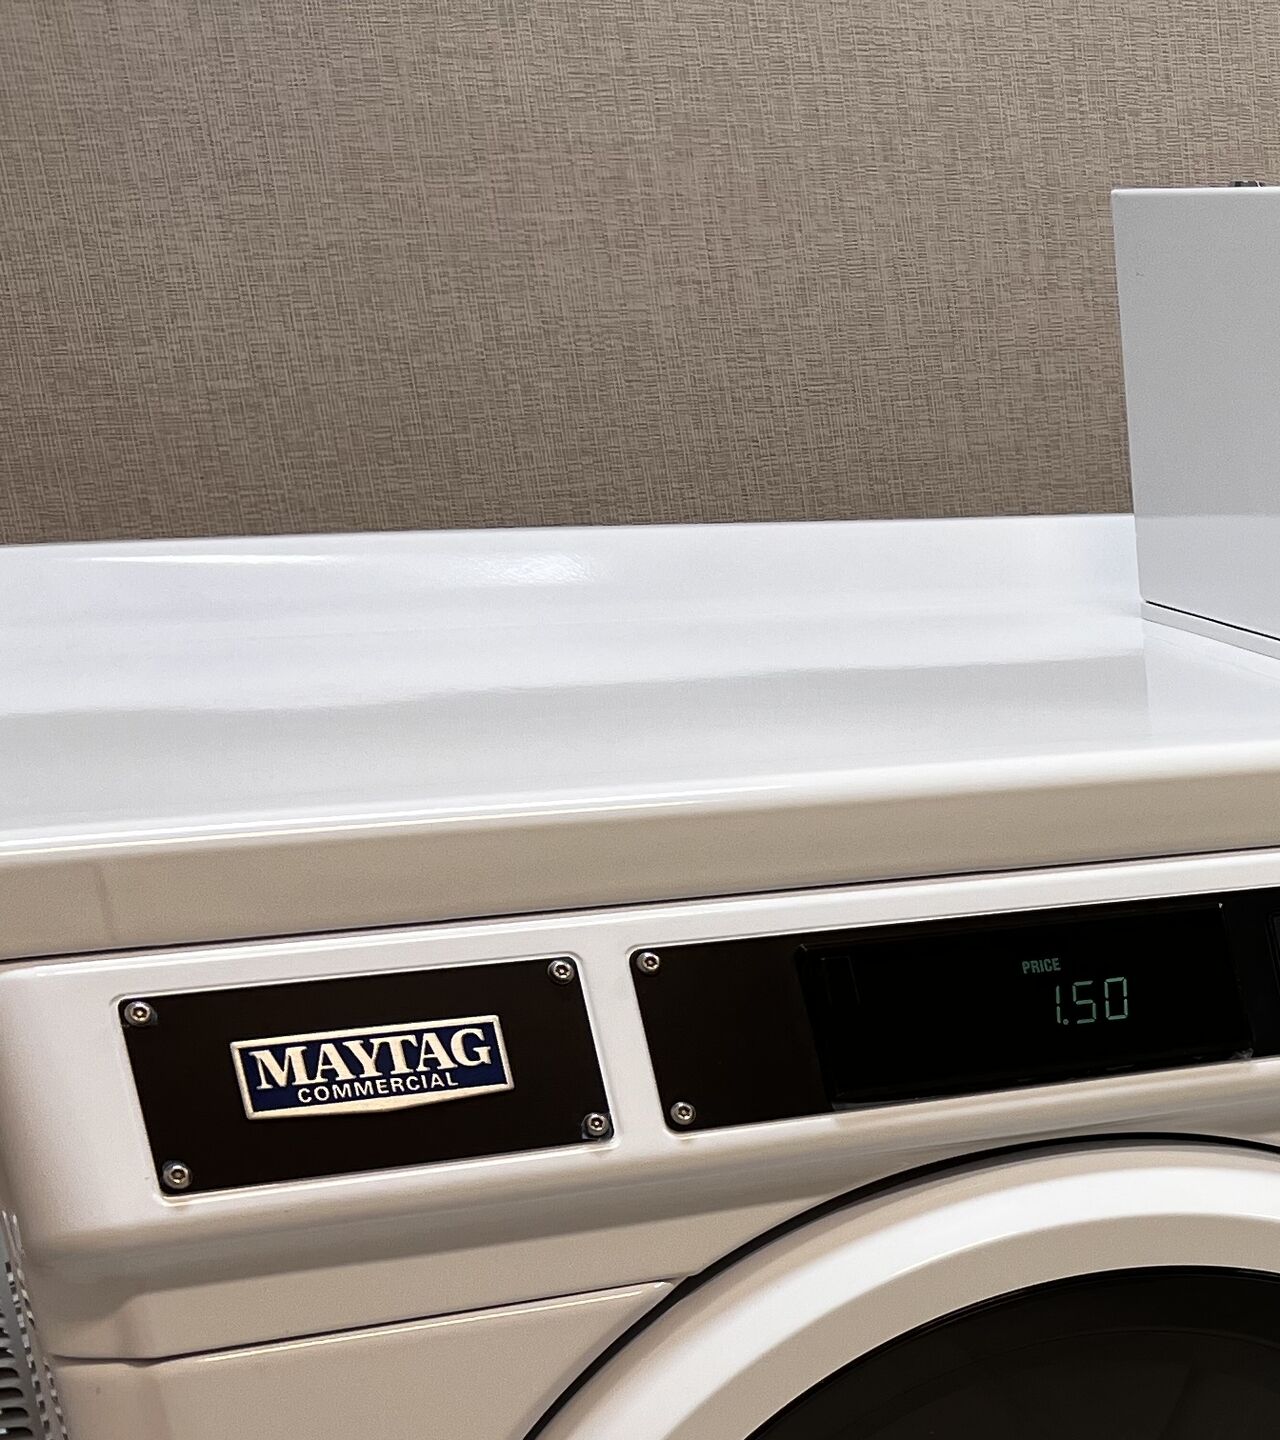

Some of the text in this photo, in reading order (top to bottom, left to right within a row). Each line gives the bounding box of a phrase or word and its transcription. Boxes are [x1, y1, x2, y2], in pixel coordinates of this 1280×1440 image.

[1021, 957, 1062, 975] PRICE
[1055, 976, 1129, 1026] 1.50
[248, 1027, 492, 1091] MAYTAG
[297, 1072, 460, 1104] COMMERCIAL
